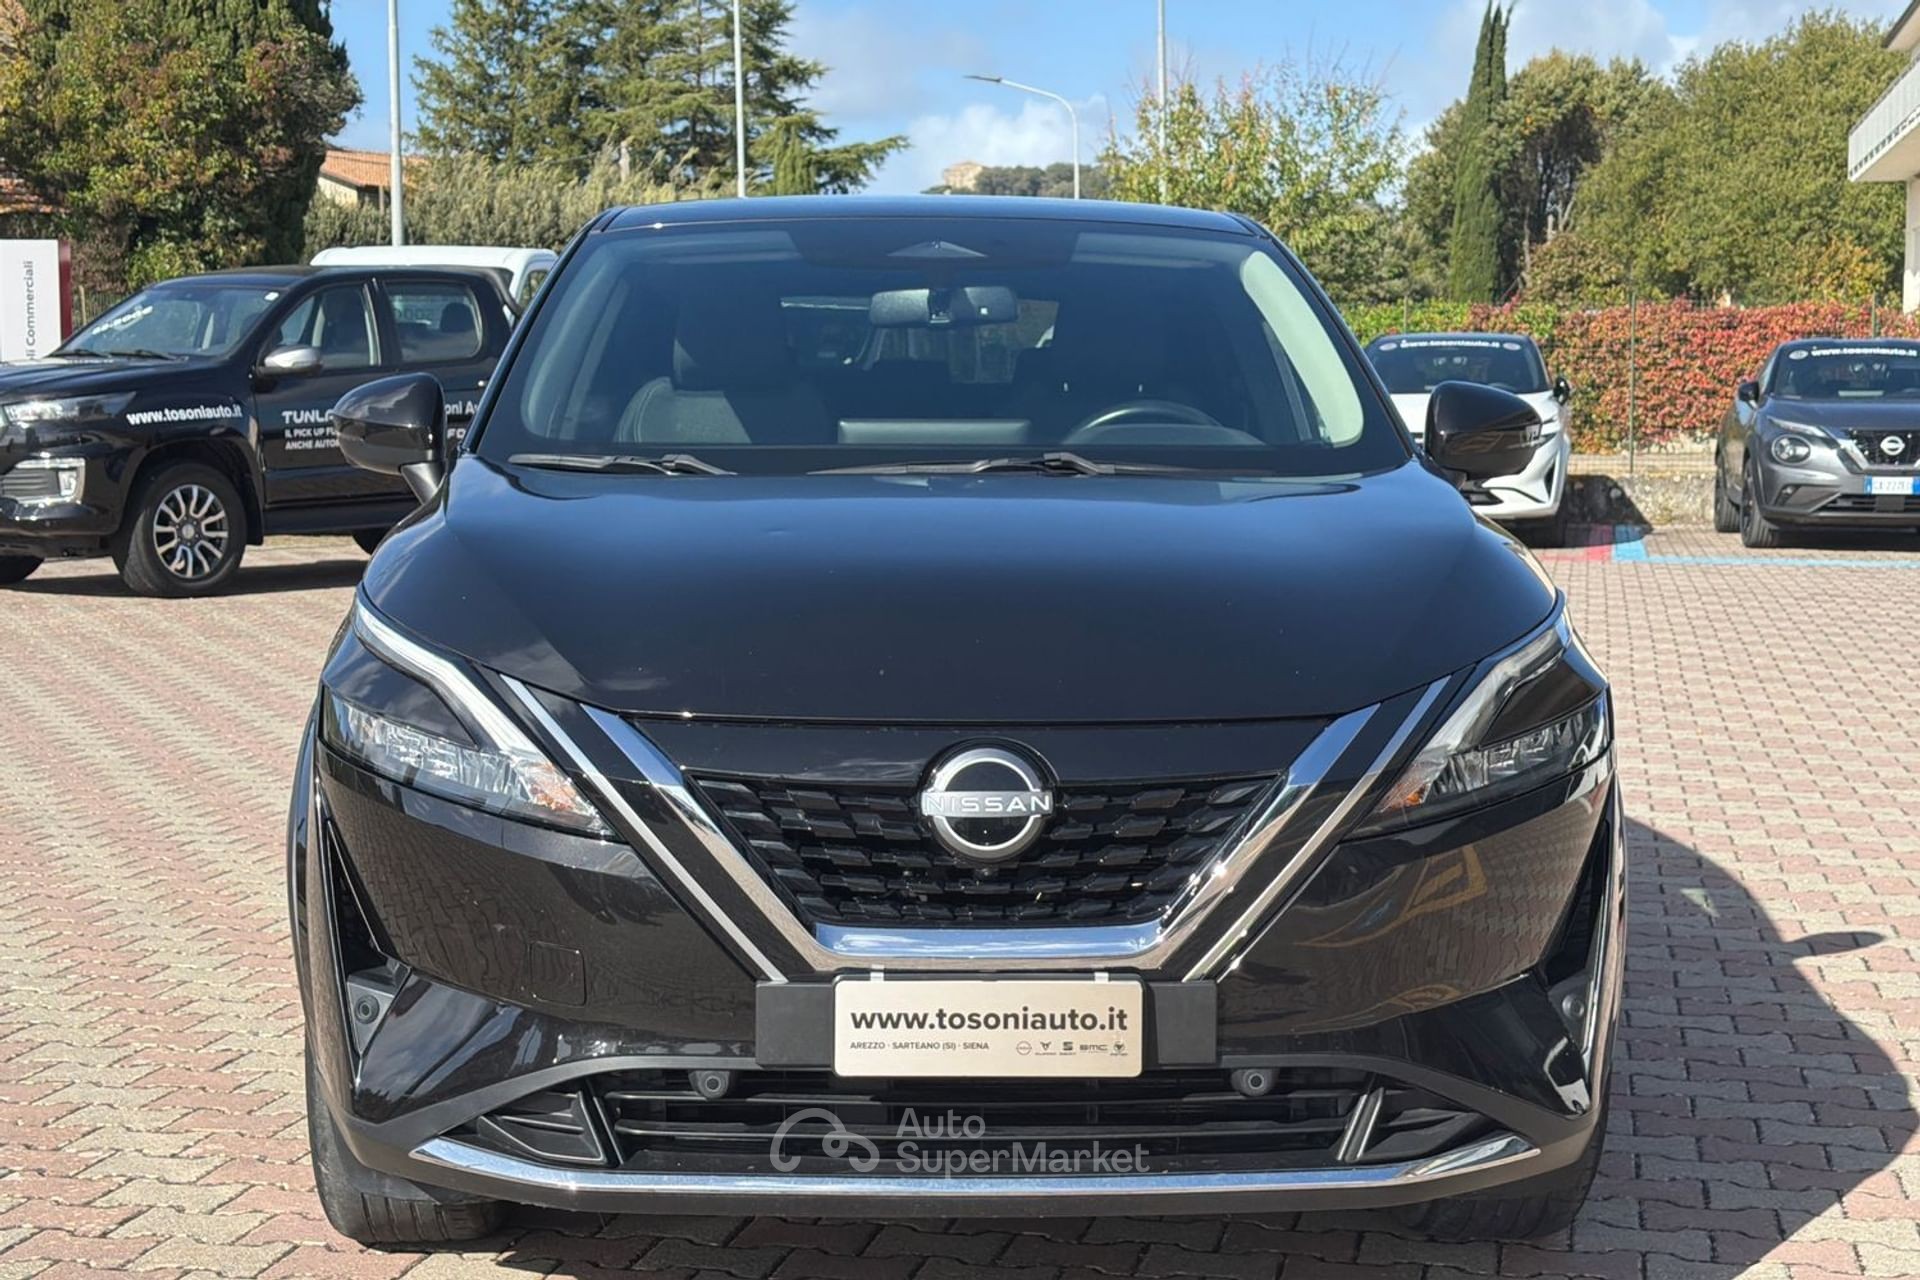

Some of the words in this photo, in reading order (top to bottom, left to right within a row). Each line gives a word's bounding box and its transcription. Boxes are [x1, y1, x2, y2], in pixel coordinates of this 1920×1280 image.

[23, 261, 36, 346] Commerciali
[126, 404, 243, 425] www.tosoniauto.it
[293, 428, 312, 438] PICK
[313, 426, 325, 437] UP
[285, 440, 313, 450] ANCHE
[926, 795, 1050, 813] NISSAN
[850, 1006, 1128, 1030] www.tosoniauto.it
[850, 1041, 886, 1050] AREZZO
[892, 1041, 941, 1050] SARTEANO
[942, 1041, 957, 1051] (SI)
[962, 1041, 990, 1050] SIENA
